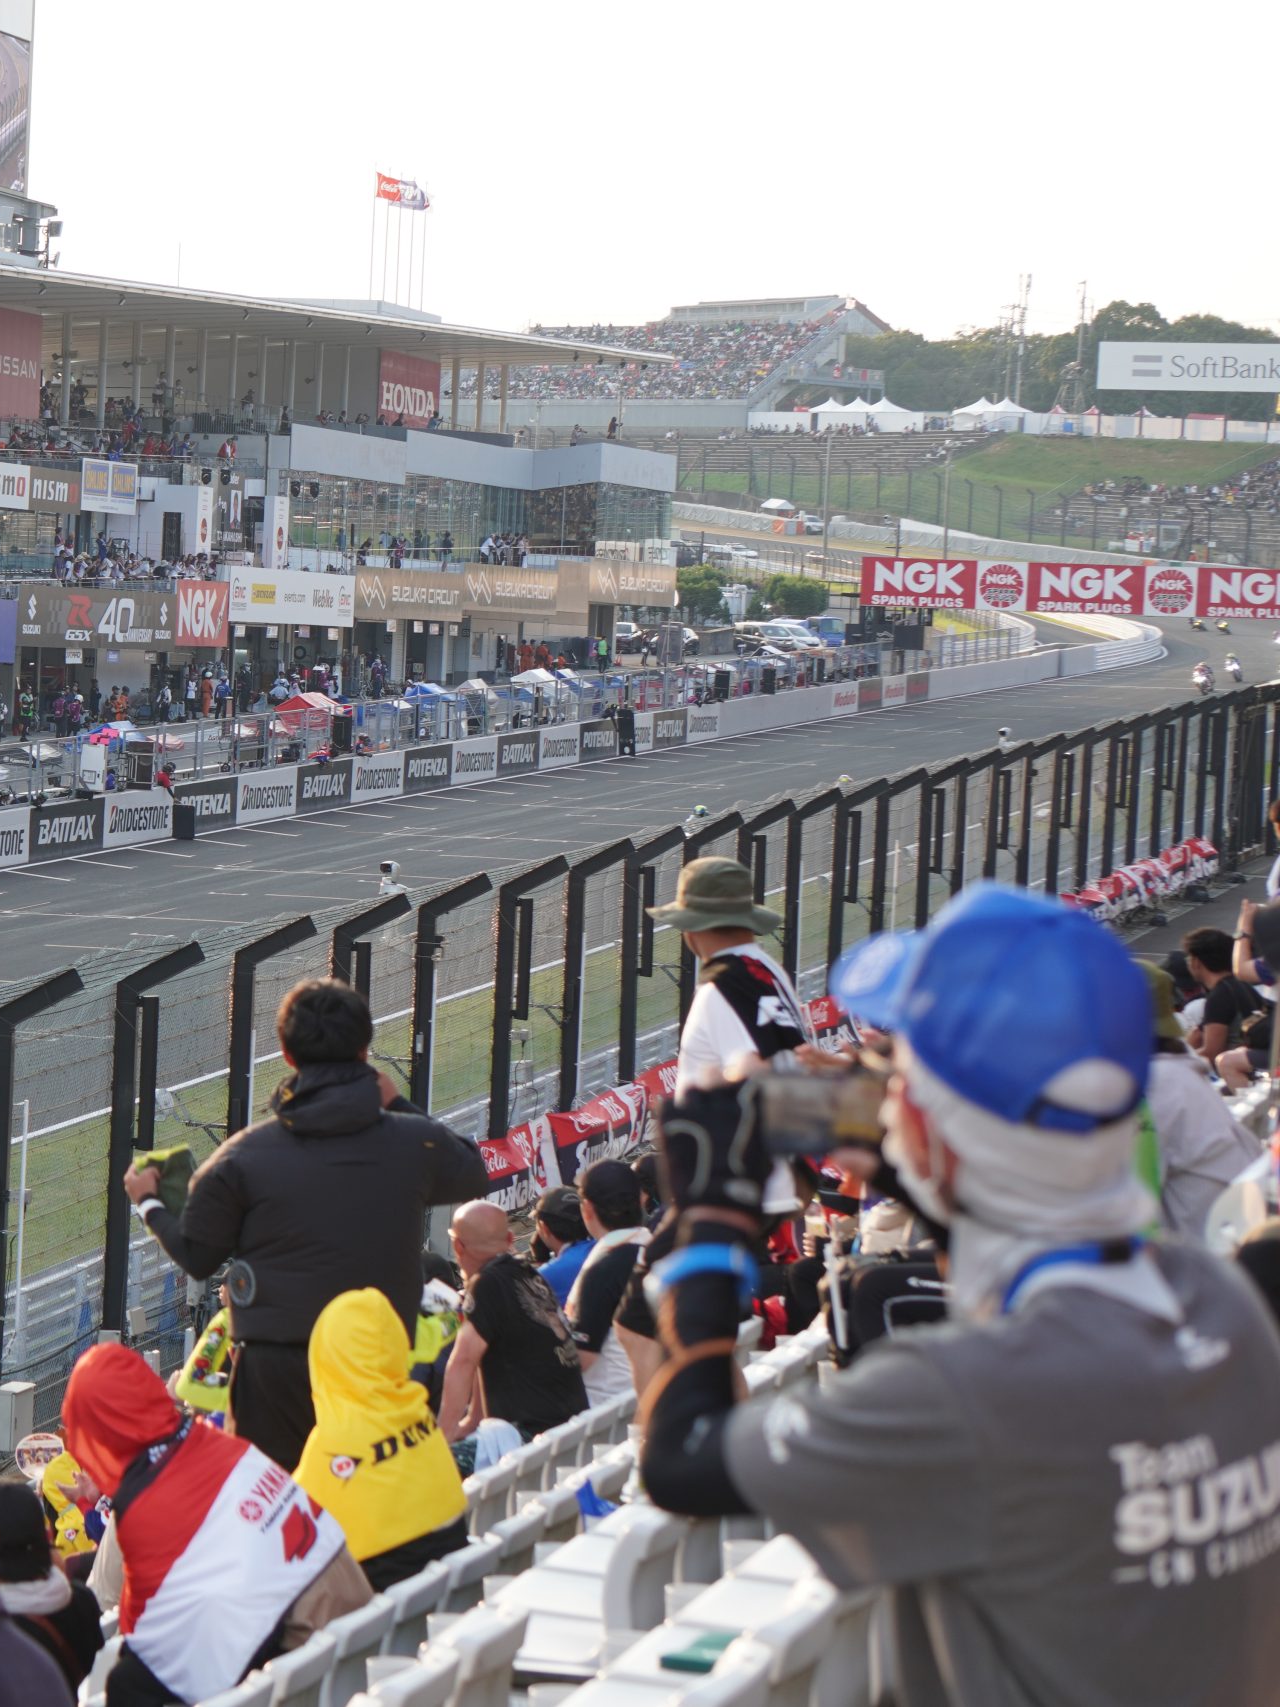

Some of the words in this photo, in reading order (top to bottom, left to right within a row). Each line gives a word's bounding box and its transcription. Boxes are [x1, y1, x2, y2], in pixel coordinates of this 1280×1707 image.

[1171, 355, 1280, 379] SoftBank
[381, 381, 435, 418] HONDA
[620, 576, 646, 591] SUZUKA
[873, 560, 966, 596] NGK
[986, 574, 1018, 585] NGK
[1040, 566, 1134, 601] NGK
[1154, 579, 1187, 591] NGK
[1209, 572, 1280, 606] NG
[392, 585, 426, 602] SUZUKA
[428, 588, 460, 605] CIRCUIT
[495, 581, 525, 598] SUZUKA
[525, 583, 555, 600] CIRCUIT
[871, 594, 915, 606] SPARK
[918, 596, 964, 608] PLUGS
[178, 588, 217, 640] NGK
[1037, 601, 1082, 613] SPARK
[1085, 602, 1132, 614] PLUGS
[1207, 606, 1253, 618] SPARK
[22, 624, 41, 635] SUZUKI
[98, 598, 135, 642] 40
[65, 629, 93, 642] GSX
[155, 629, 171, 640] SUZUKI
[656, 720, 685, 738] BATTLAX
[689, 715, 719, 735] BRIDGESTONE
[543, 737, 578, 759] BRIDGESTONE
[583, 731, 614, 748] POTENZA
[455, 750, 495, 773] BRIDGESTONE
[501, 743, 536, 765] BATTLAX
[356, 766, 401, 791] BRIDGESTONE
[408, 758, 448, 778] POTENZA
[302, 773, 347, 799] BATTLAX
[241, 784, 293, 811] BRIDGESTONE
[38, 814, 97, 845] BATTLAX
[109, 805, 170, 833] BRIDGESTONE
[1109, 1433, 1218, 1490] Team
